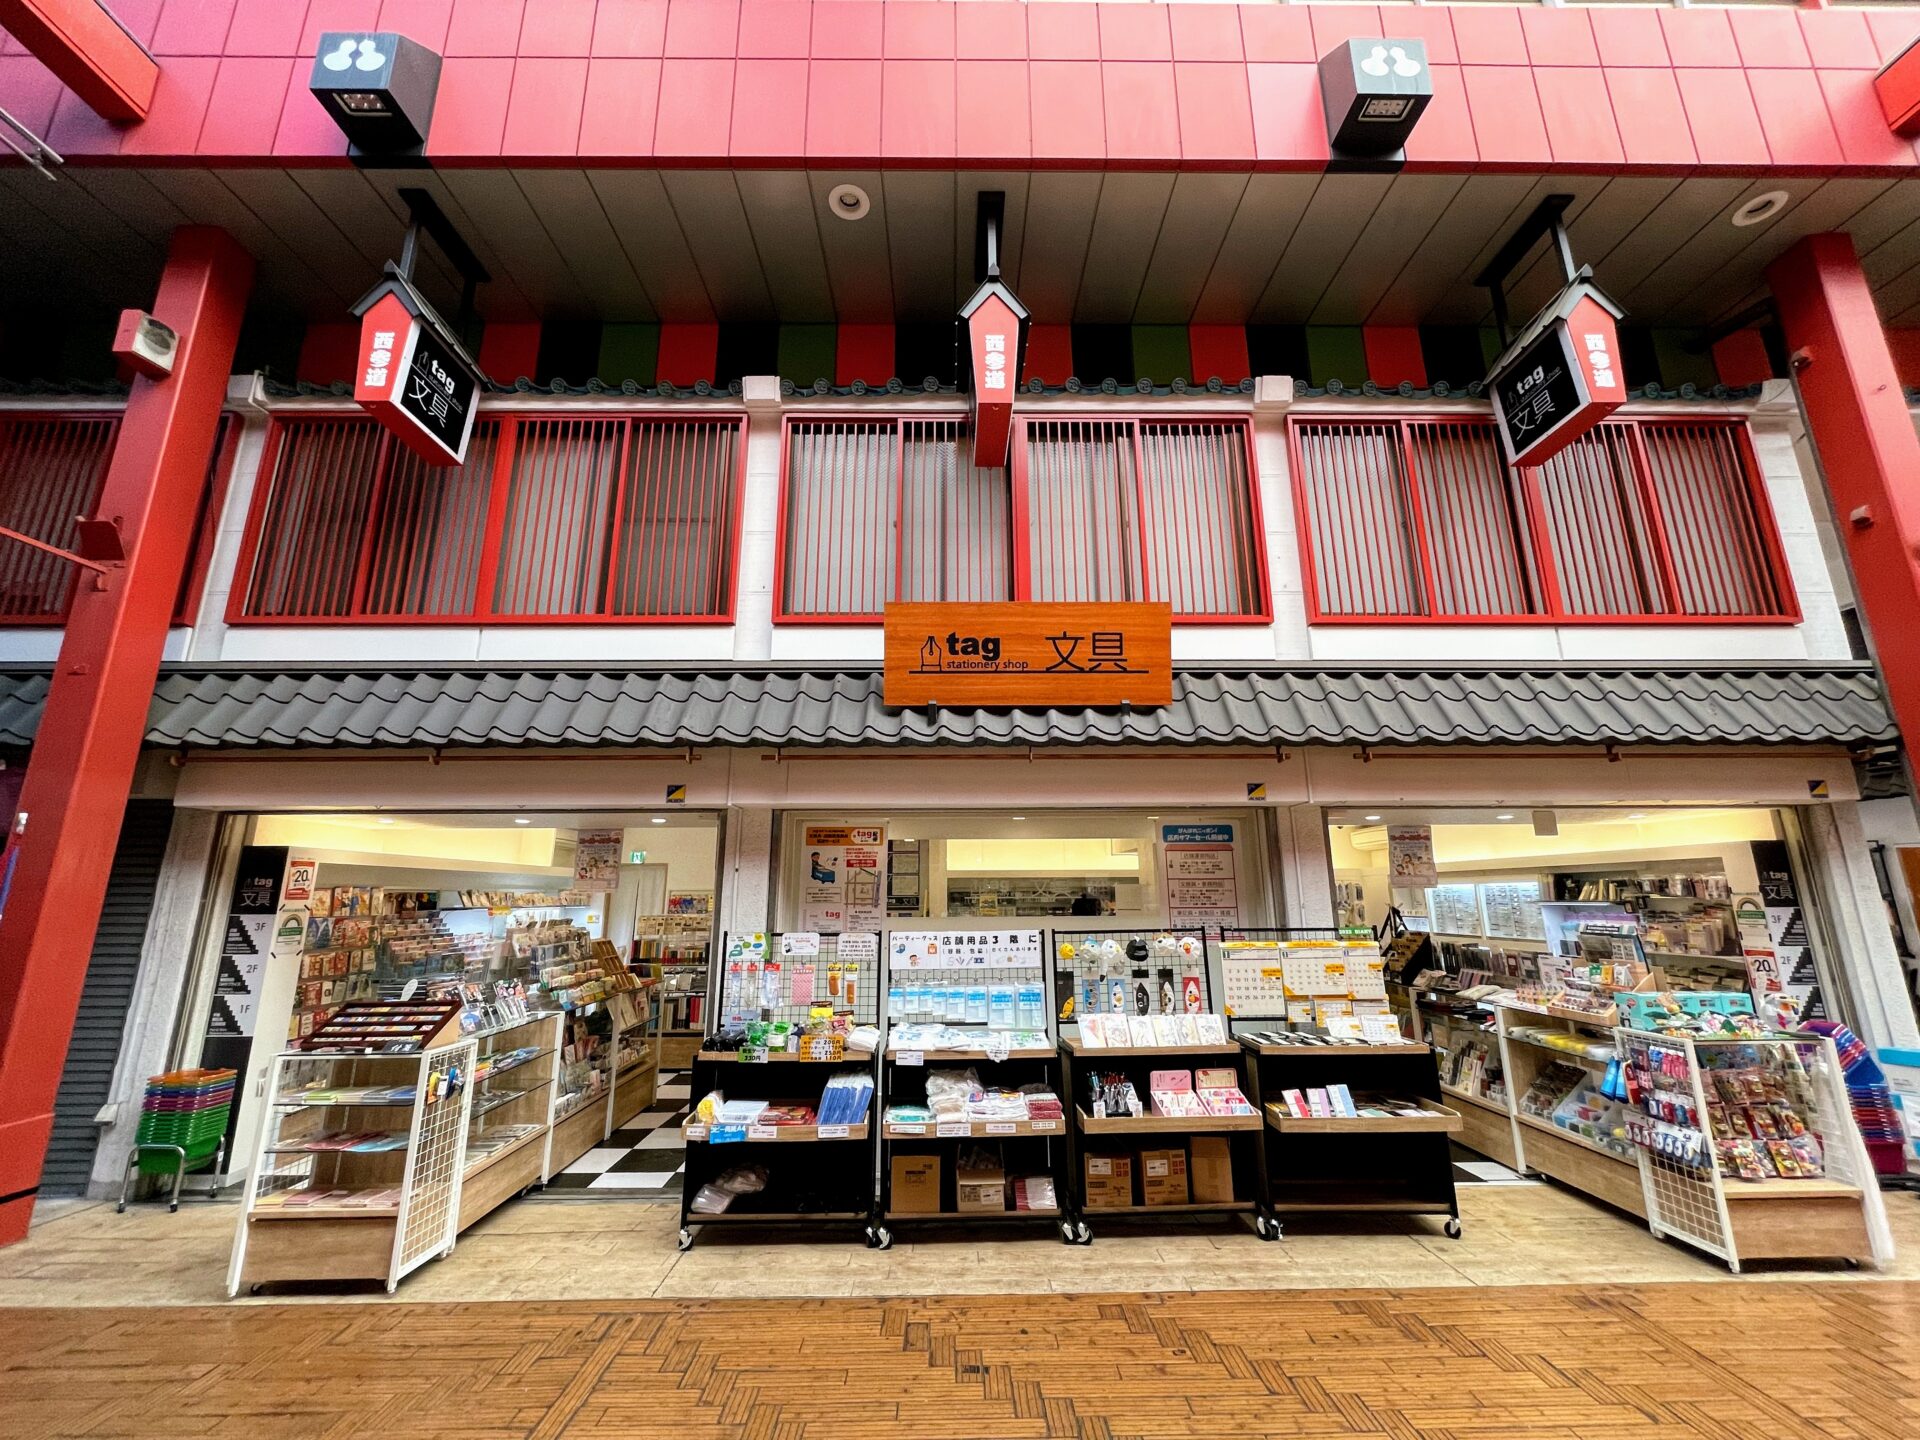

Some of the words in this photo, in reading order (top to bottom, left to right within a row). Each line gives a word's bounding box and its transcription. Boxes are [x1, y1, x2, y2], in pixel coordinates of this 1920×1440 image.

[431, 360, 456, 394] tag
[1516, 365, 1545, 395] tag
[408, 375, 449, 428] 文具
[1511, 389, 1556, 441] 文具
[945, 631, 1001, 661] tag
[1045, 631, 1128, 672] 文具
[946, 659, 1000, 672] stationery
[1002, 659, 1029, 672] shop
[857, 830, 873, 839] tag
[1769, 870, 1789, 880] tag
[254, 877, 274, 888] tag
[1765, 885, 1795, 900] 文具
[239, 892, 271, 908] 文具
[825, 911, 841, 919] tag
[1771, 914, 1782, 924] 3F
[254, 922, 267, 932] 3F
[942, 935, 989, 946] 店舗用品
[1780, 956, 1791, 965] 2F
[245, 964, 259, 974] 2F
[240, 1004, 251, 1014] 1F
